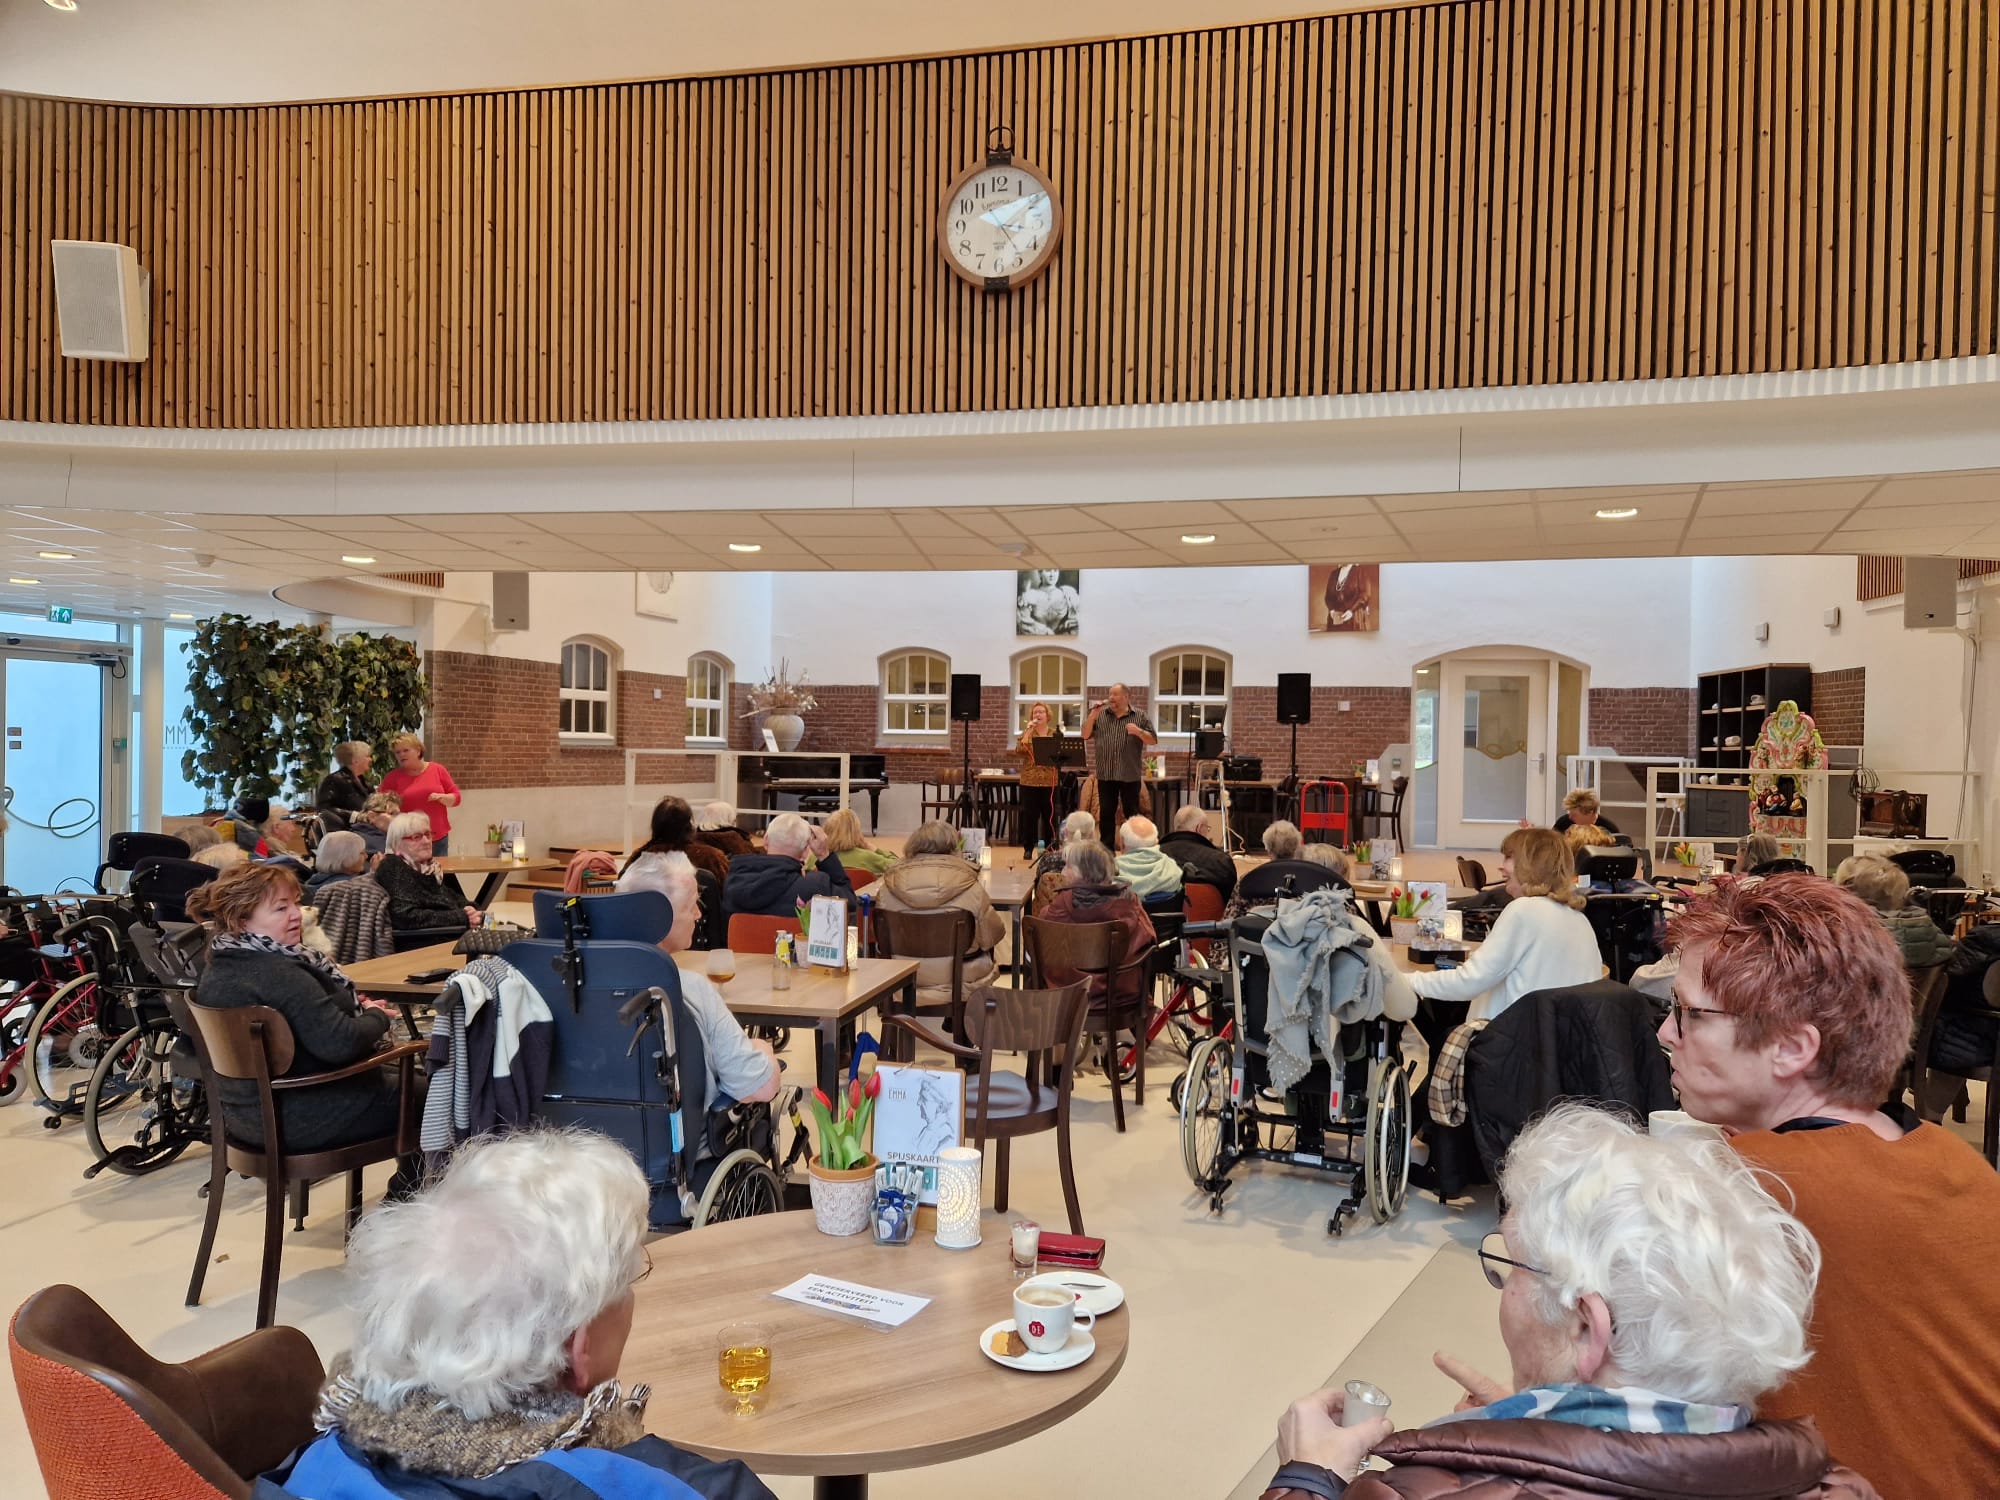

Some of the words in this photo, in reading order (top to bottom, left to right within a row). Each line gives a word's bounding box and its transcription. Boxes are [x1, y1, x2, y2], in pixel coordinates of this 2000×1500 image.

[975, 182, 986, 199] 11
[991, 176, 1008, 192] 12
[1017, 180, 1023, 196] 1
[960, 199, 974, 215] 10
[955, 220, 967, 235] 9
[959, 239, 972, 256] 8
[1026, 235, 1040, 251] 4
[975, 253, 986, 270] 7
[993, 258, 1004, 274] 6
[1011, 252, 1023, 268] 5
[888, 1089, 907, 1100] EMMA
[887, 1151, 941, 1164] SPIJSKAART
[814, 1282, 878, 1300] GERESERVEERD
[880, 1297, 904, 1306] VOOR
